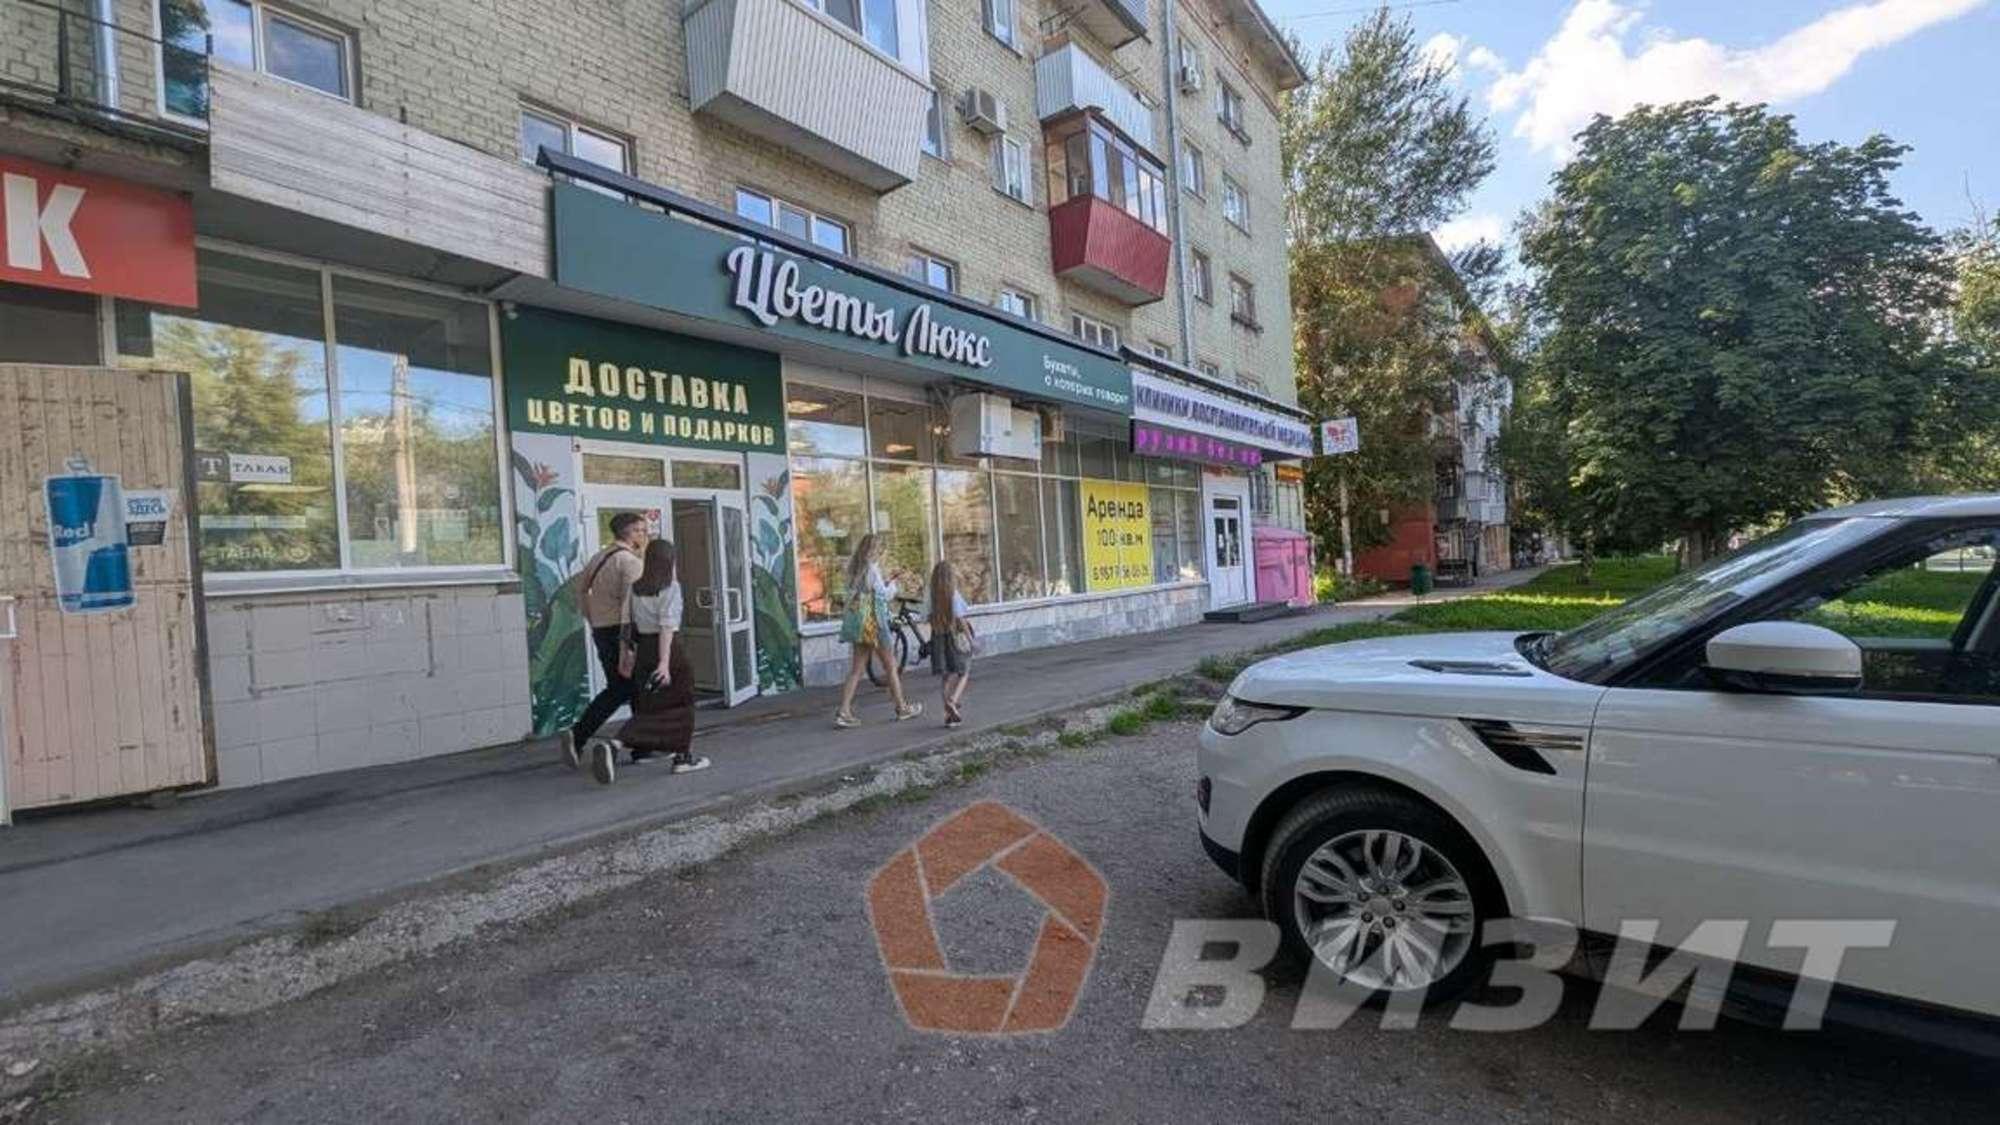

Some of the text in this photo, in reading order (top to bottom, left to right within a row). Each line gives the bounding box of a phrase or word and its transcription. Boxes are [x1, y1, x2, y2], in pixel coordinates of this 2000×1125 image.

[727, 246, 993, 368] Цветы Люкс
[564, 356, 750, 415] ДОСТАВКА
[1135, 384, 1190, 419] КЛИНИКИ
[527, 398, 776, 447] ЦВЕТОВ И ПОДАРКОВ
[231, 461, 291, 476] ТАБАК
[1087, 493, 1144, 523] Аренда
[1096, 528, 1116, 547] 100
